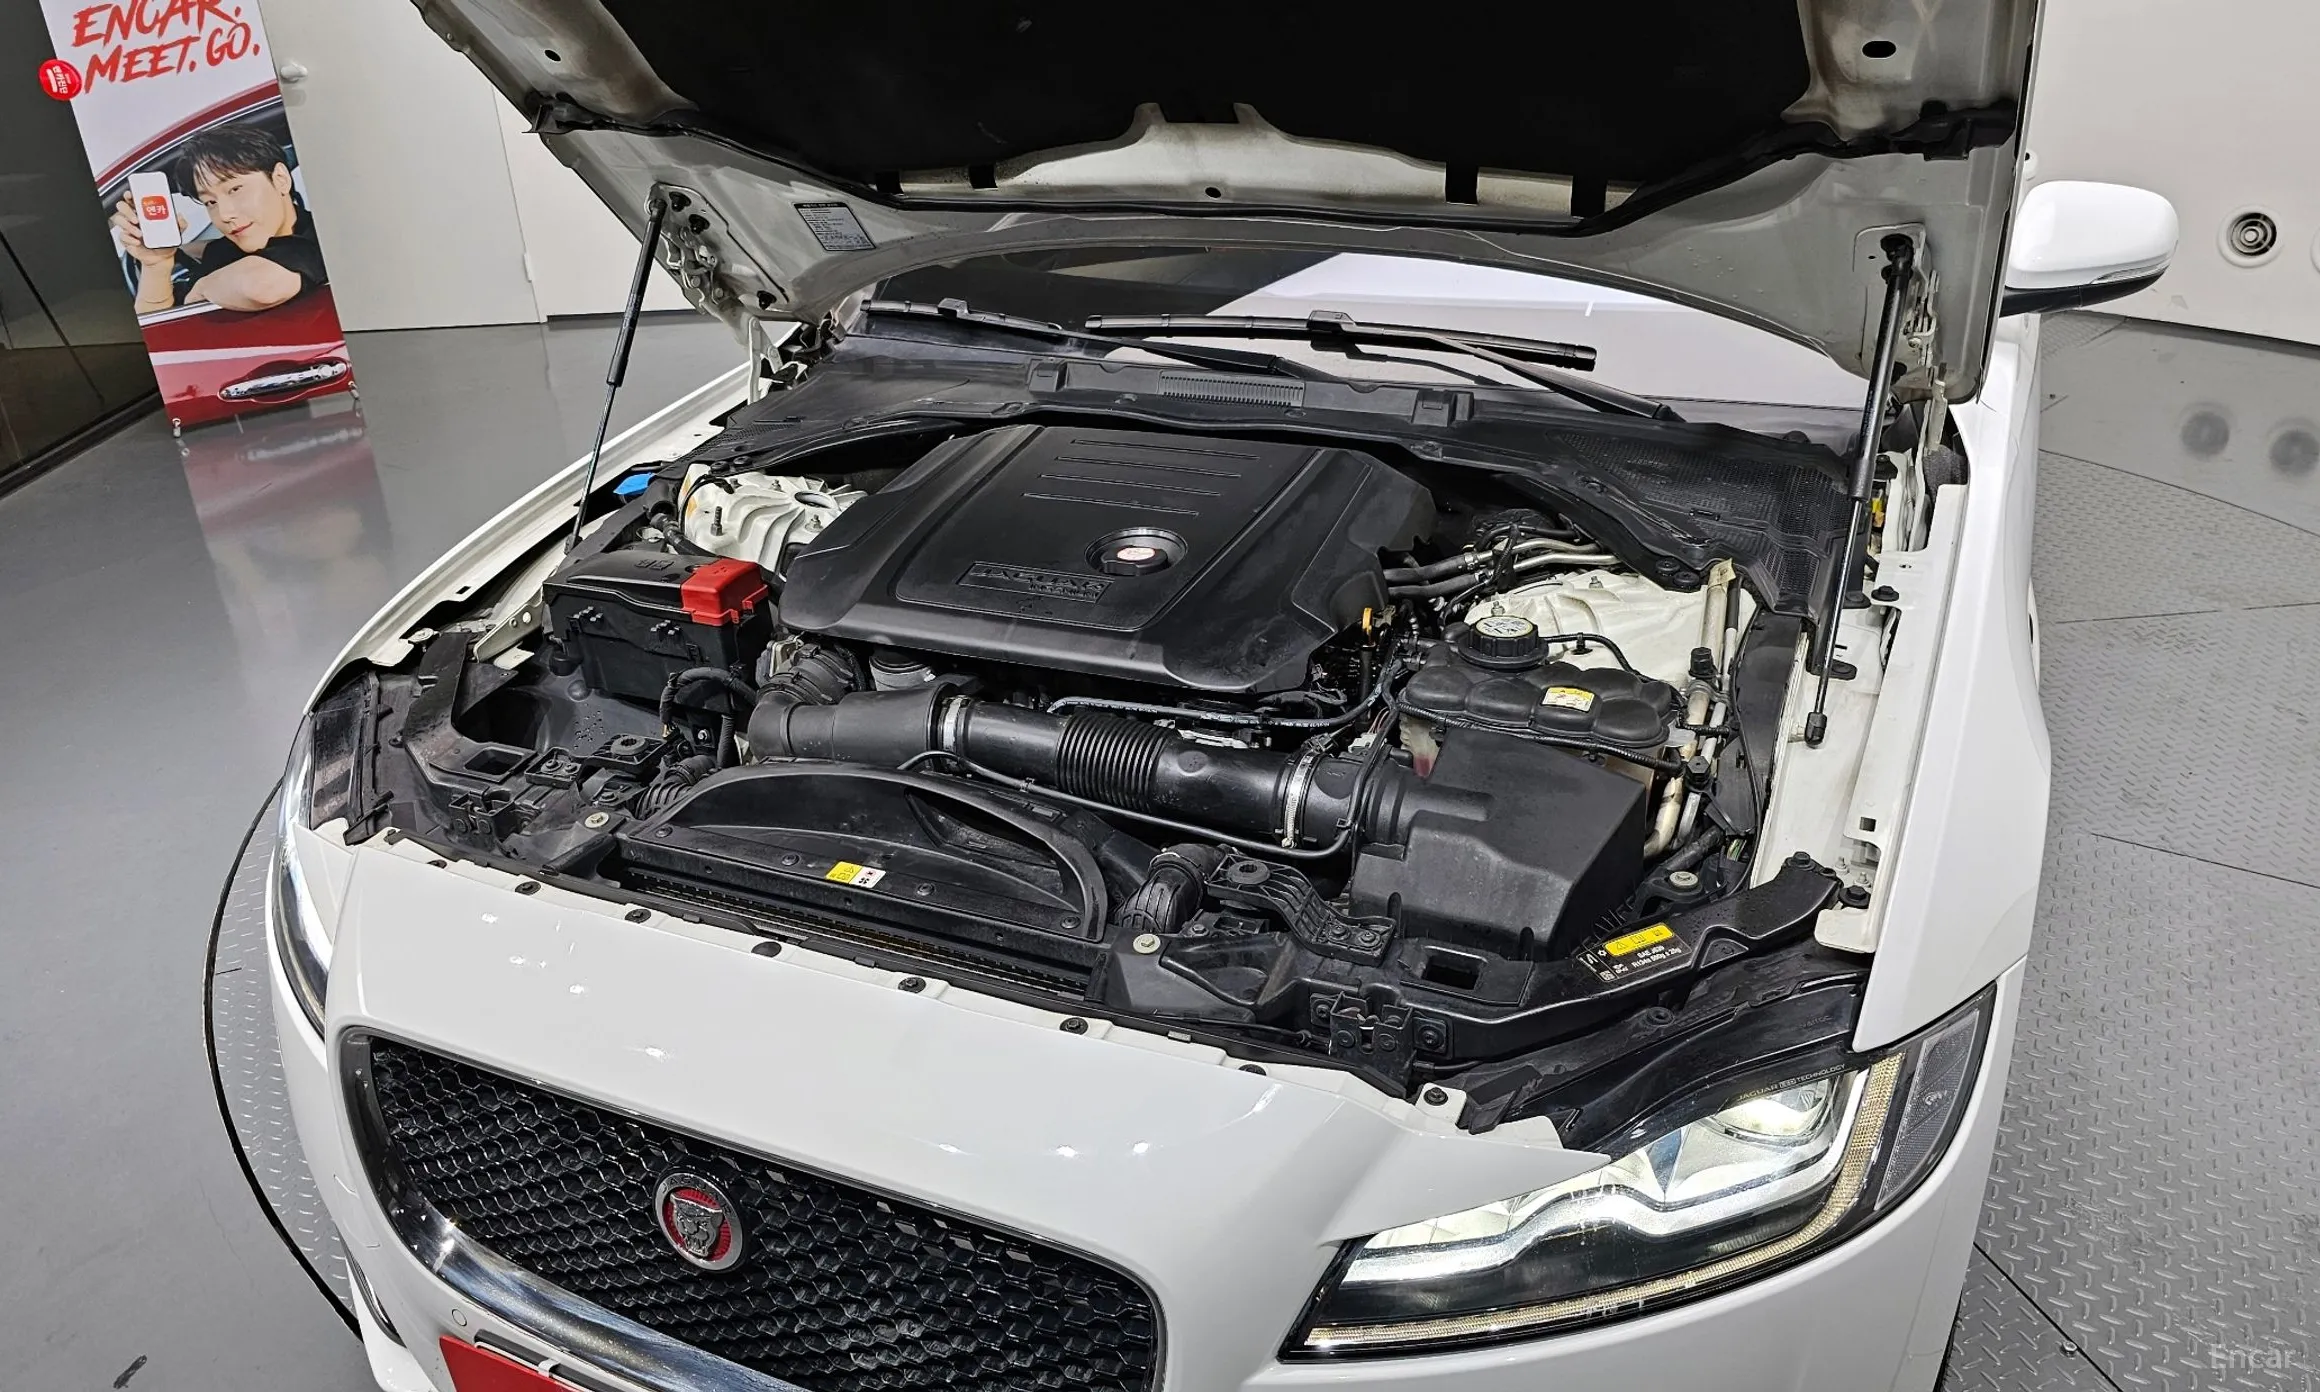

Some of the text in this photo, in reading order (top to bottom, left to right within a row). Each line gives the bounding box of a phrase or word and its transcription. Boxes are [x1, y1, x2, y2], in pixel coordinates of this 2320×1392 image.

[72, 0, 242, 47] ENCAR.
[84, 22, 260, 94] MEET. GO.
[1739, 1084, 1778, 1101] JAGUAR
[1797, 1063, 1845, 1082] TECHNOLOGY
